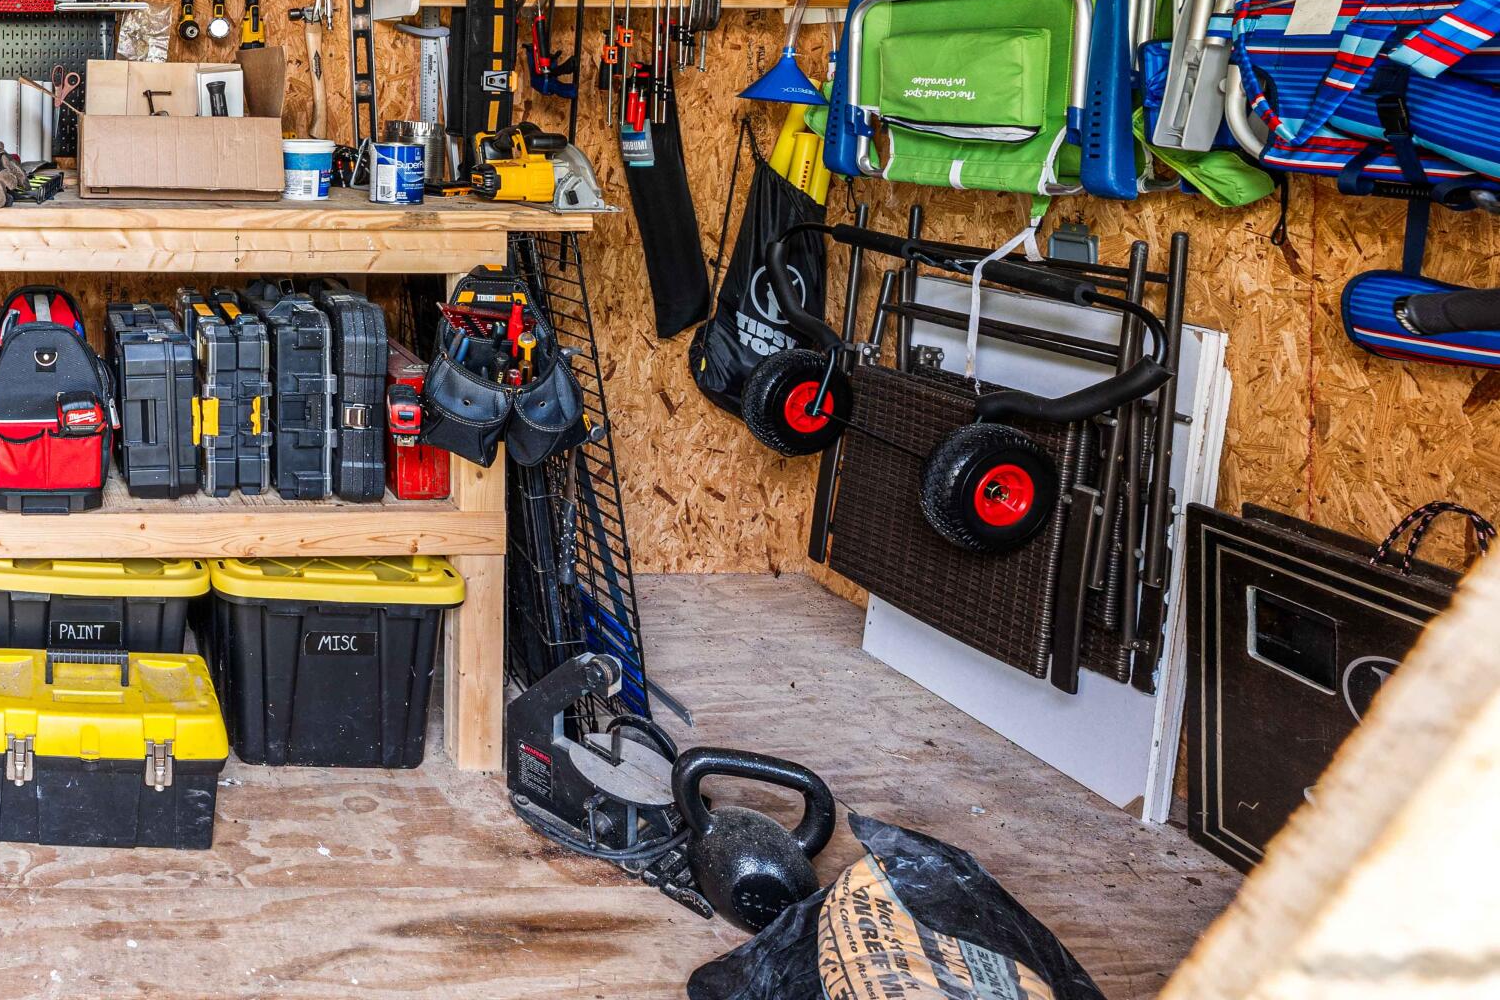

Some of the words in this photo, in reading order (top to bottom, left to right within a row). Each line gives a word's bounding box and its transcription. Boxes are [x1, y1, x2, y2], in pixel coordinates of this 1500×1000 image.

[911, 77, 952, 87] Paradise
[904, 88, 923, 98] Spot
[924, 89, 957, 99] Coolest
[957, 91, 976, 100] The
[58, 623, 105, 641] PAINT
[317, 634, 358, 653] MISC
[525, 745, 551, 766] WARNING
